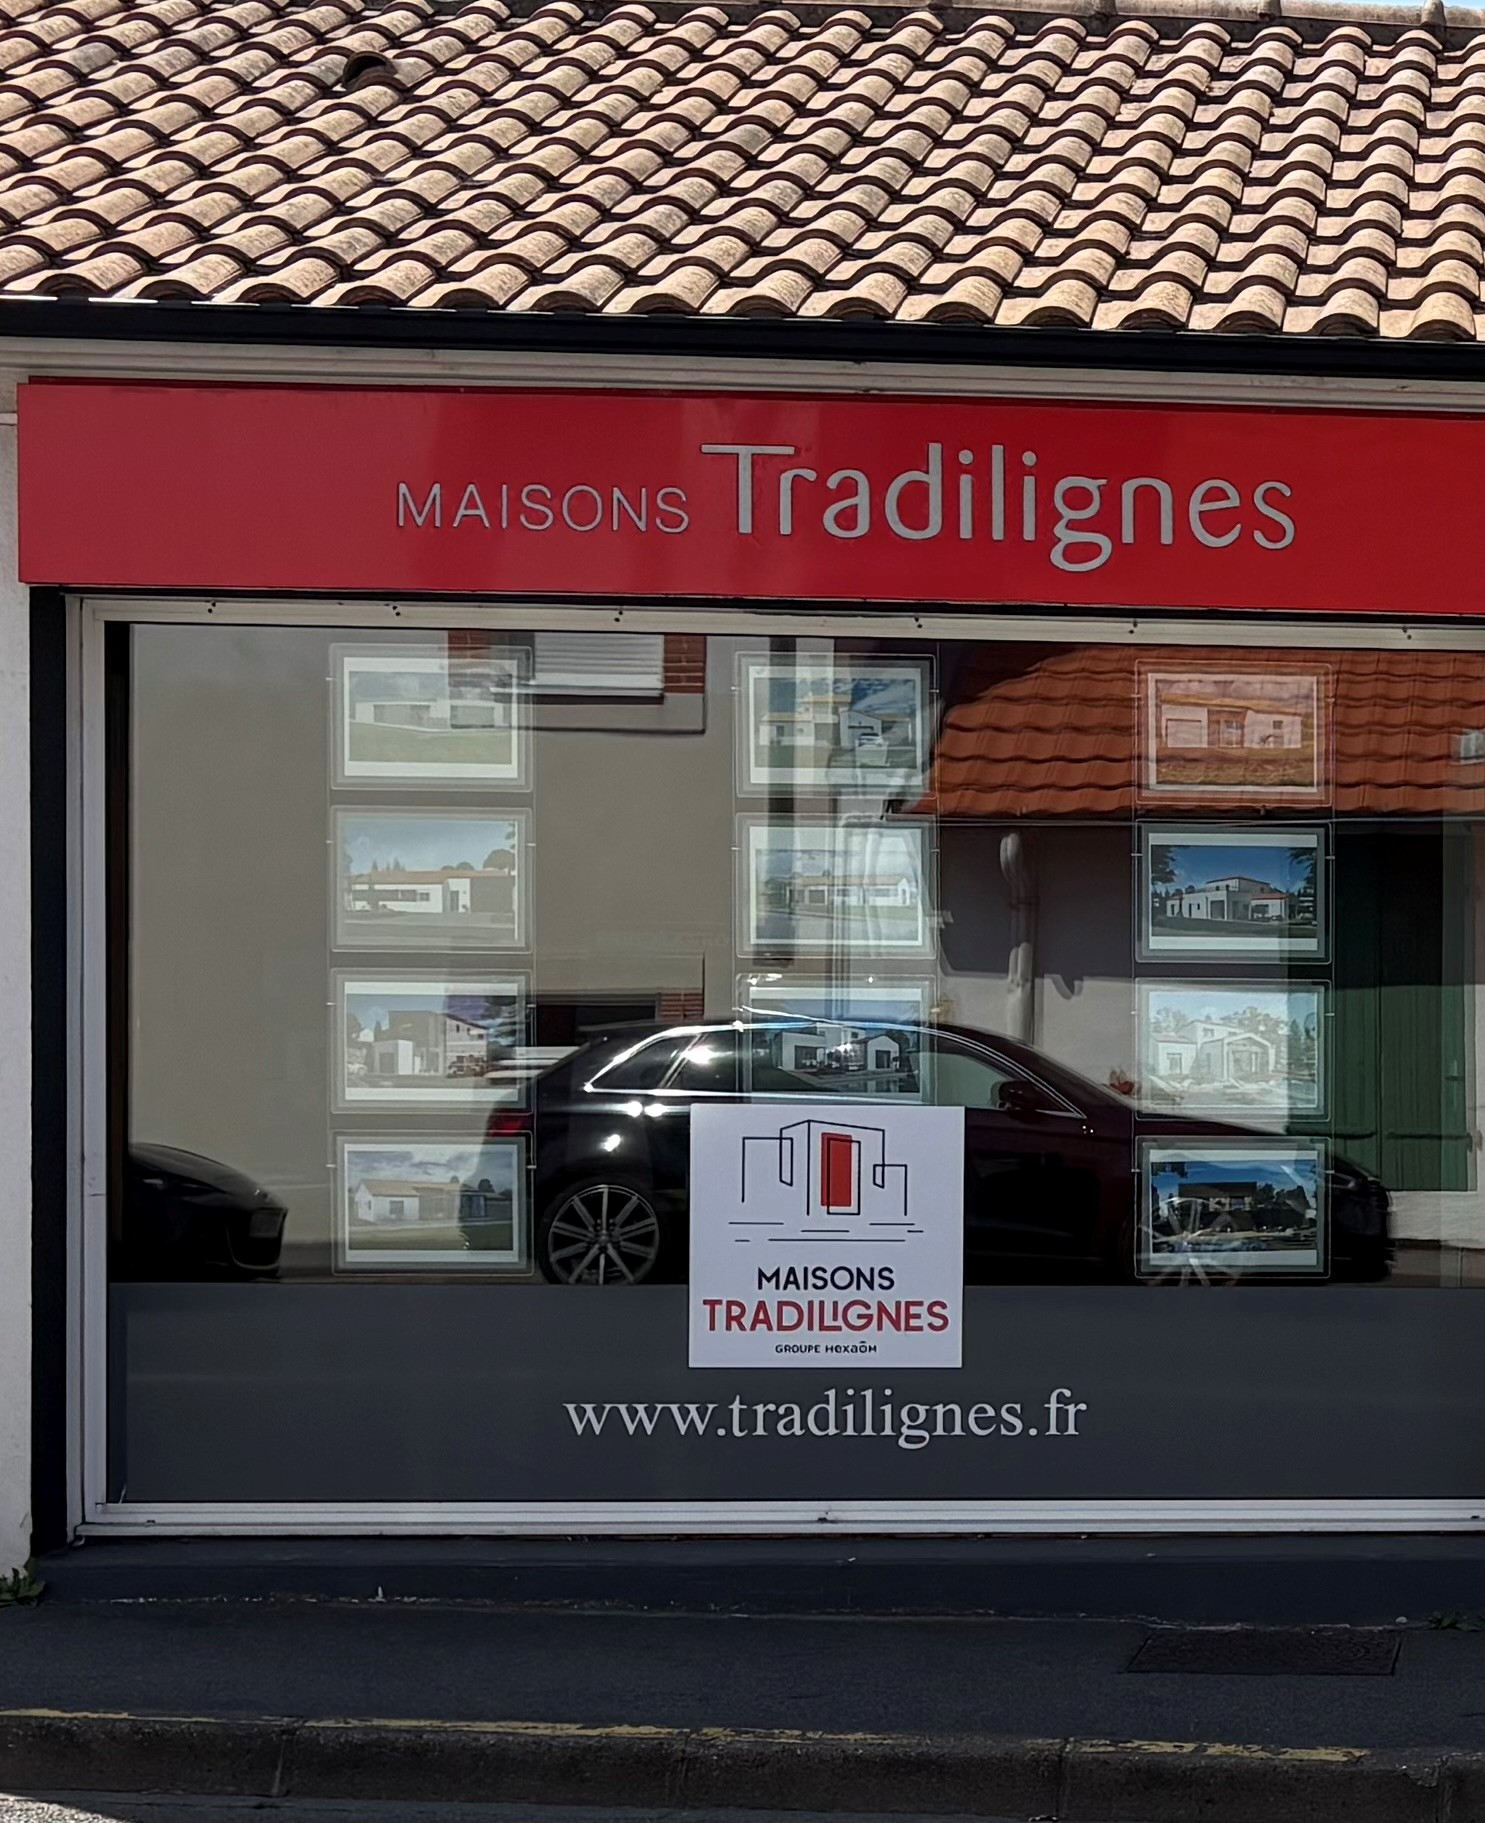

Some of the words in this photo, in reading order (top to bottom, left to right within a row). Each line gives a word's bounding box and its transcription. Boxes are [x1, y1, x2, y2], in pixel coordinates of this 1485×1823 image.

[395, 480, 690, 535] MAISONS
[700, 442, 1297, 573] Tradilignes
[757, 1266, 895, 1291] MAISONS
[702, 1299, 949, 1332] TRADILIGNES
[774, 1344, 821, 1354] GROUPE
[562, 1388, 1088, 1450] www.tradilignes.fr
